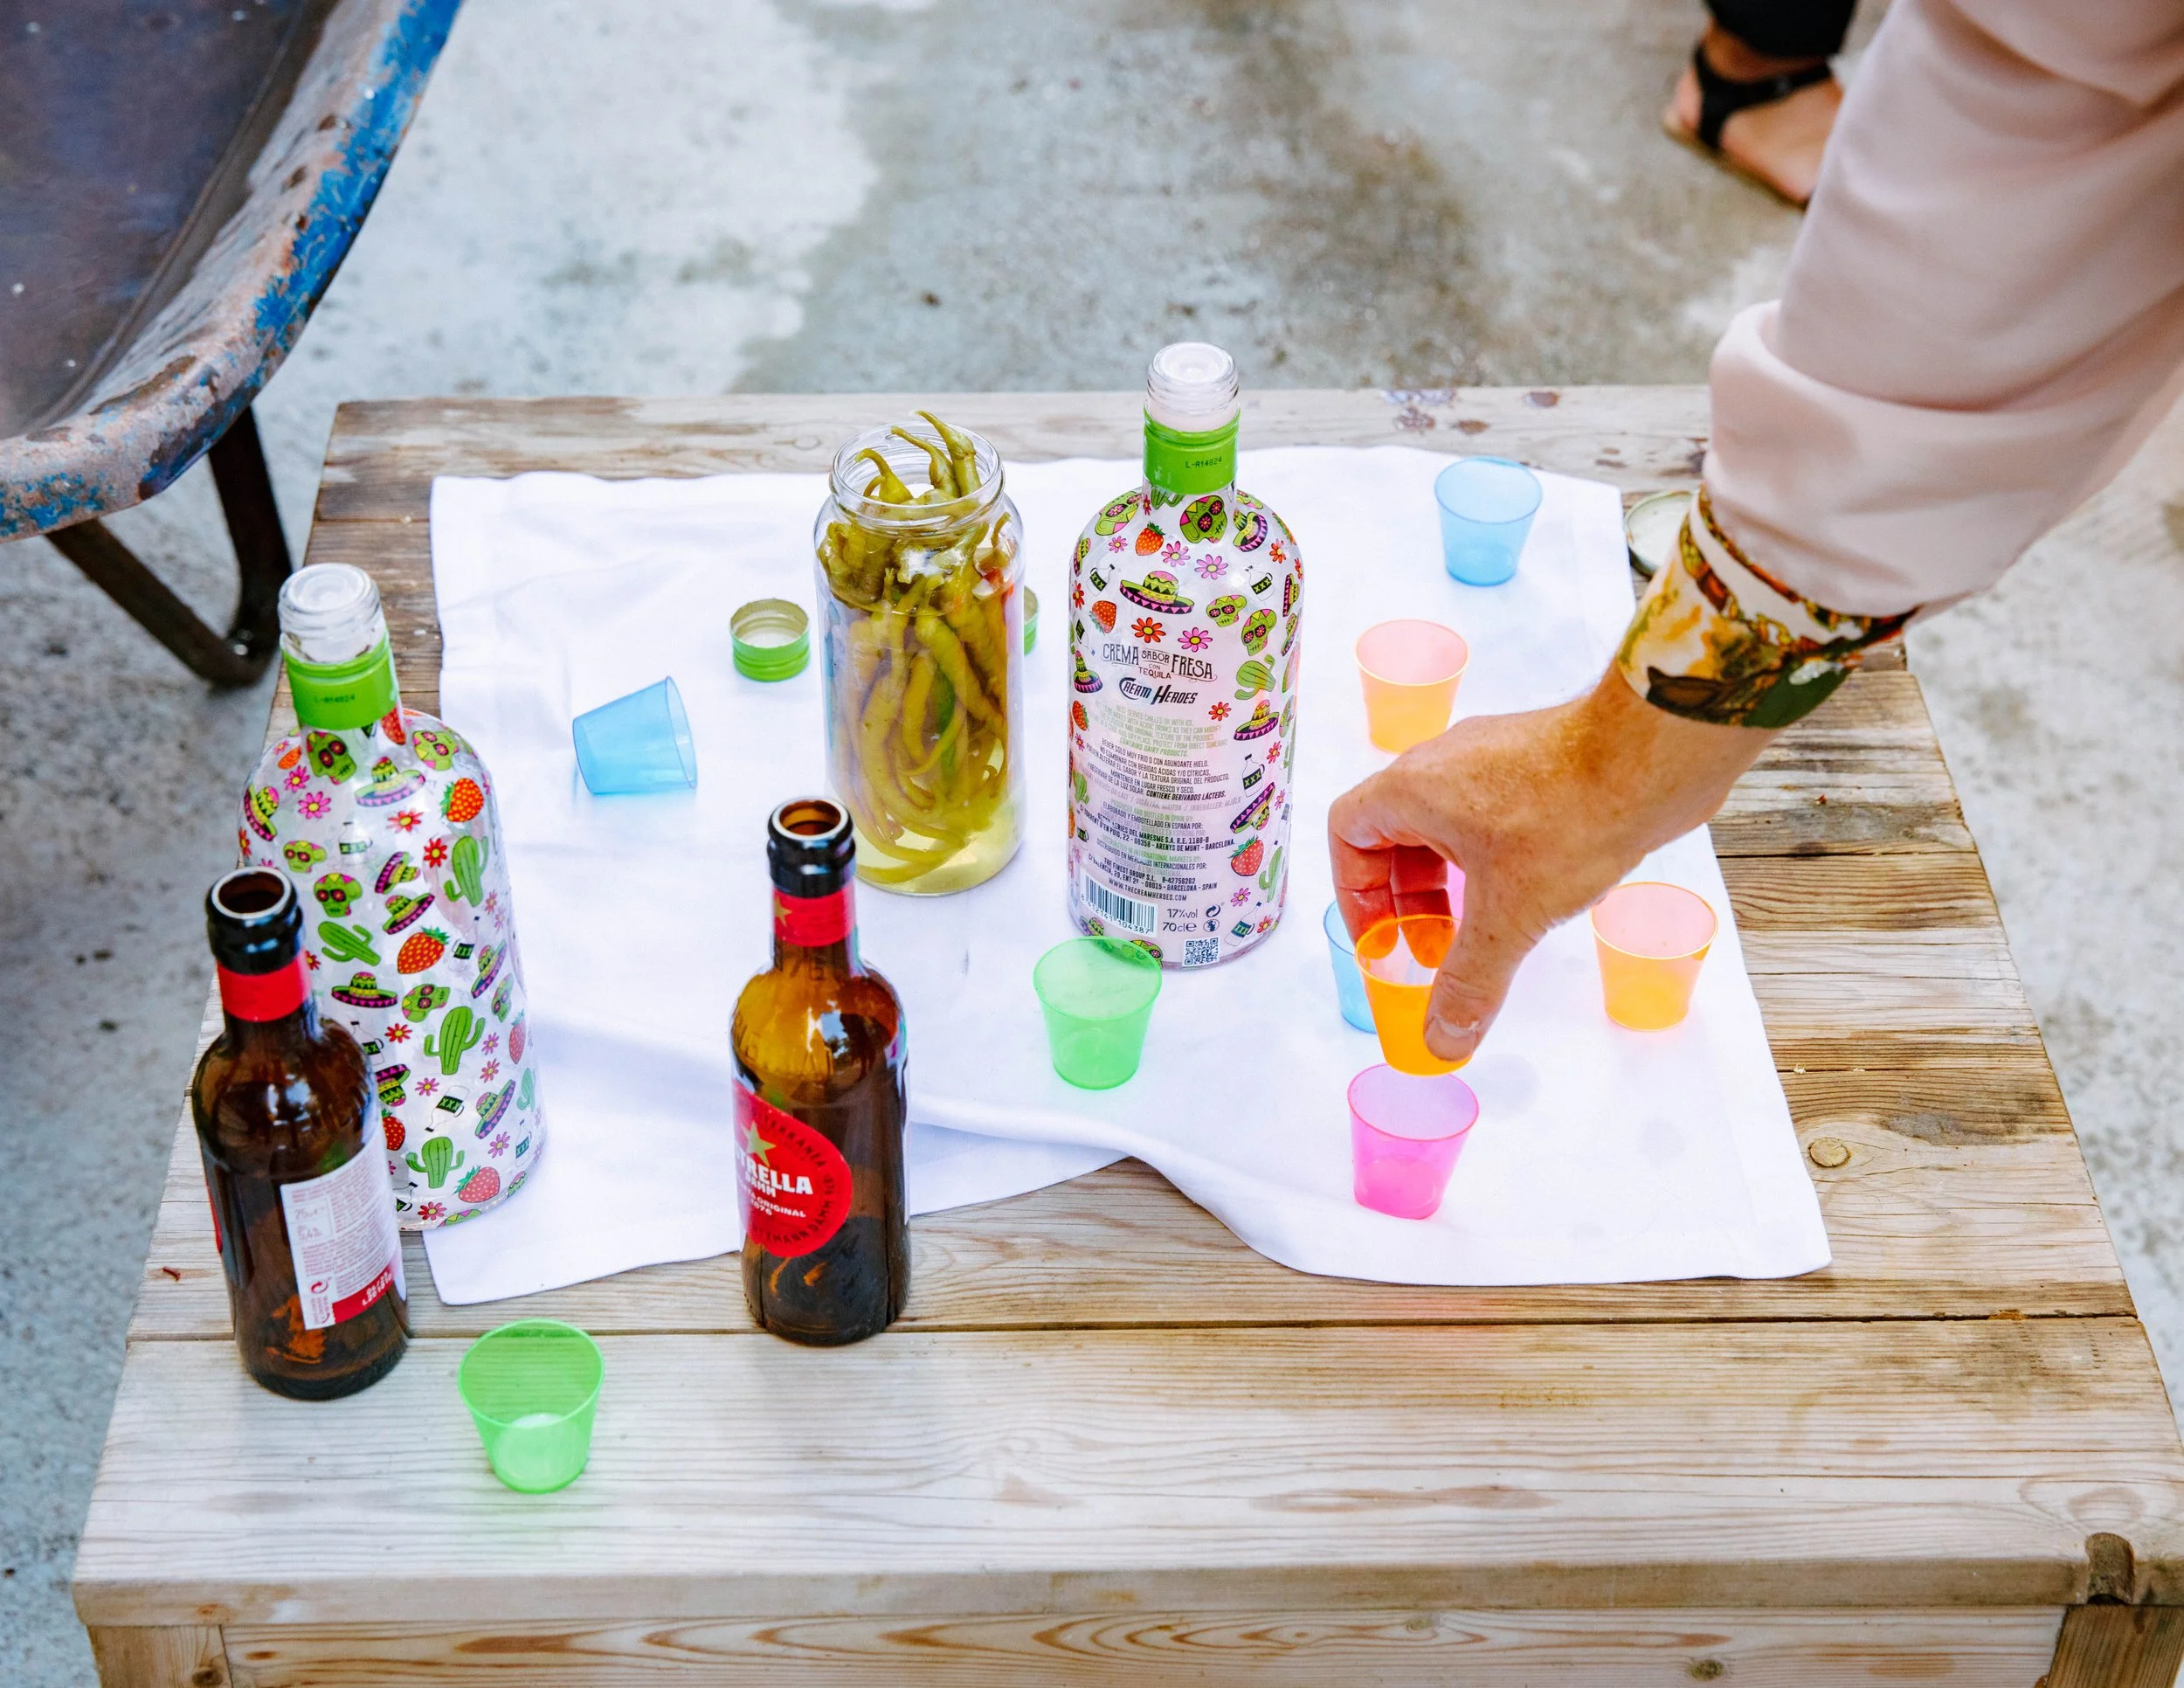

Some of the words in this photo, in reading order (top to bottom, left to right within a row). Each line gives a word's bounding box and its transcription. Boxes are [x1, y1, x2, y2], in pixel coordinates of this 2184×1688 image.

[1102, 643, 1139, 666] CREMA
[1141, 649, 1171, 664] SABOR
[1171, 654, 1213, 680] FRESA
[1138, 666, 1171, 679] TEQUILA
[1119, 677, 1152, 701] CREAM
[1150, 684, 1199, 705] HEROES
[1115, 744, 1126, 756] SOLO
[1127, 749, 1137, 759] MUY
[1153, 757, 1164, 766] CON
[1164, 758, 1192, 768] ABUNDANTE
[1193, 759, 1209, 768] HIELO.
[1174, 741, 1188, 750] FROM
[1099, 753, 1116, 768] ALTERAR
[1116, 762, 1122, 771] EL
[1122, 765, 1137, 778] SABOR
[1149, 772, 1171, 785] TEXTURA
[1171, 777, 1192, 785] ORIGINAL
[1204, 772, 1230, 784] PRODUCTO.
[1106, 749, 1128, 766] COMBINAR
[1128, 759, 1137, 769] CON
[1137, 763, 1158, 774] BEBIDAS
[1108, 775, 1114, 784] DE
[1114, 778, 1120, 787] LA
[1120, 780, 1129, 791] LUZ
[1145, 789, 1171, 800] CONTIENE
[1201, 790, 1227, 801] LÁCTEOS.
[1110, 769, 1134, 785] MANTENER
[1134, 778, 1141, 787] EN
[1141, 780, 1158, 791] LUGAR
[1157, 784, 1176, 793] FRESCO
[1102, 801, 1127, 819] ELABORADO
[1130, 813, 1165, 828] EMBOTELLADO
[1164, 820, 1171, 829] EN
[1171, 821, 1191, 830] ESPAÑA
[1171, 813, 1185, 822] SPAIN
[1123, 833, 1130, 842] 22
[1155, 841, 1176, 852] ARENYS
[1205, 838, 1236, 851] BARCELONA.
[1129, 827, 1138, 838] DEL
[1138, 831, 1165, 842] MARESME
[1103, 856, 1112, 866] THE
[1112, 861, 1129, 875] FINEST
[1129, 868, 1146, 879] GROUP
[1121, 850, 1127, 860] EN
[1153, 860, 1195, 870] INTERNACIONALES
[1195, 861, 1207, 870] POR:
[1108, 876, 1187, 902] WWW.THECREAMHEROES.COM
[1123, 874, 1132, 883] ENT
[1201, 882, 1218, 891] SPAIN
[1117, 919, 1151, 935] 104387
[757, 1196, 806, 1218] ORIGINAL
